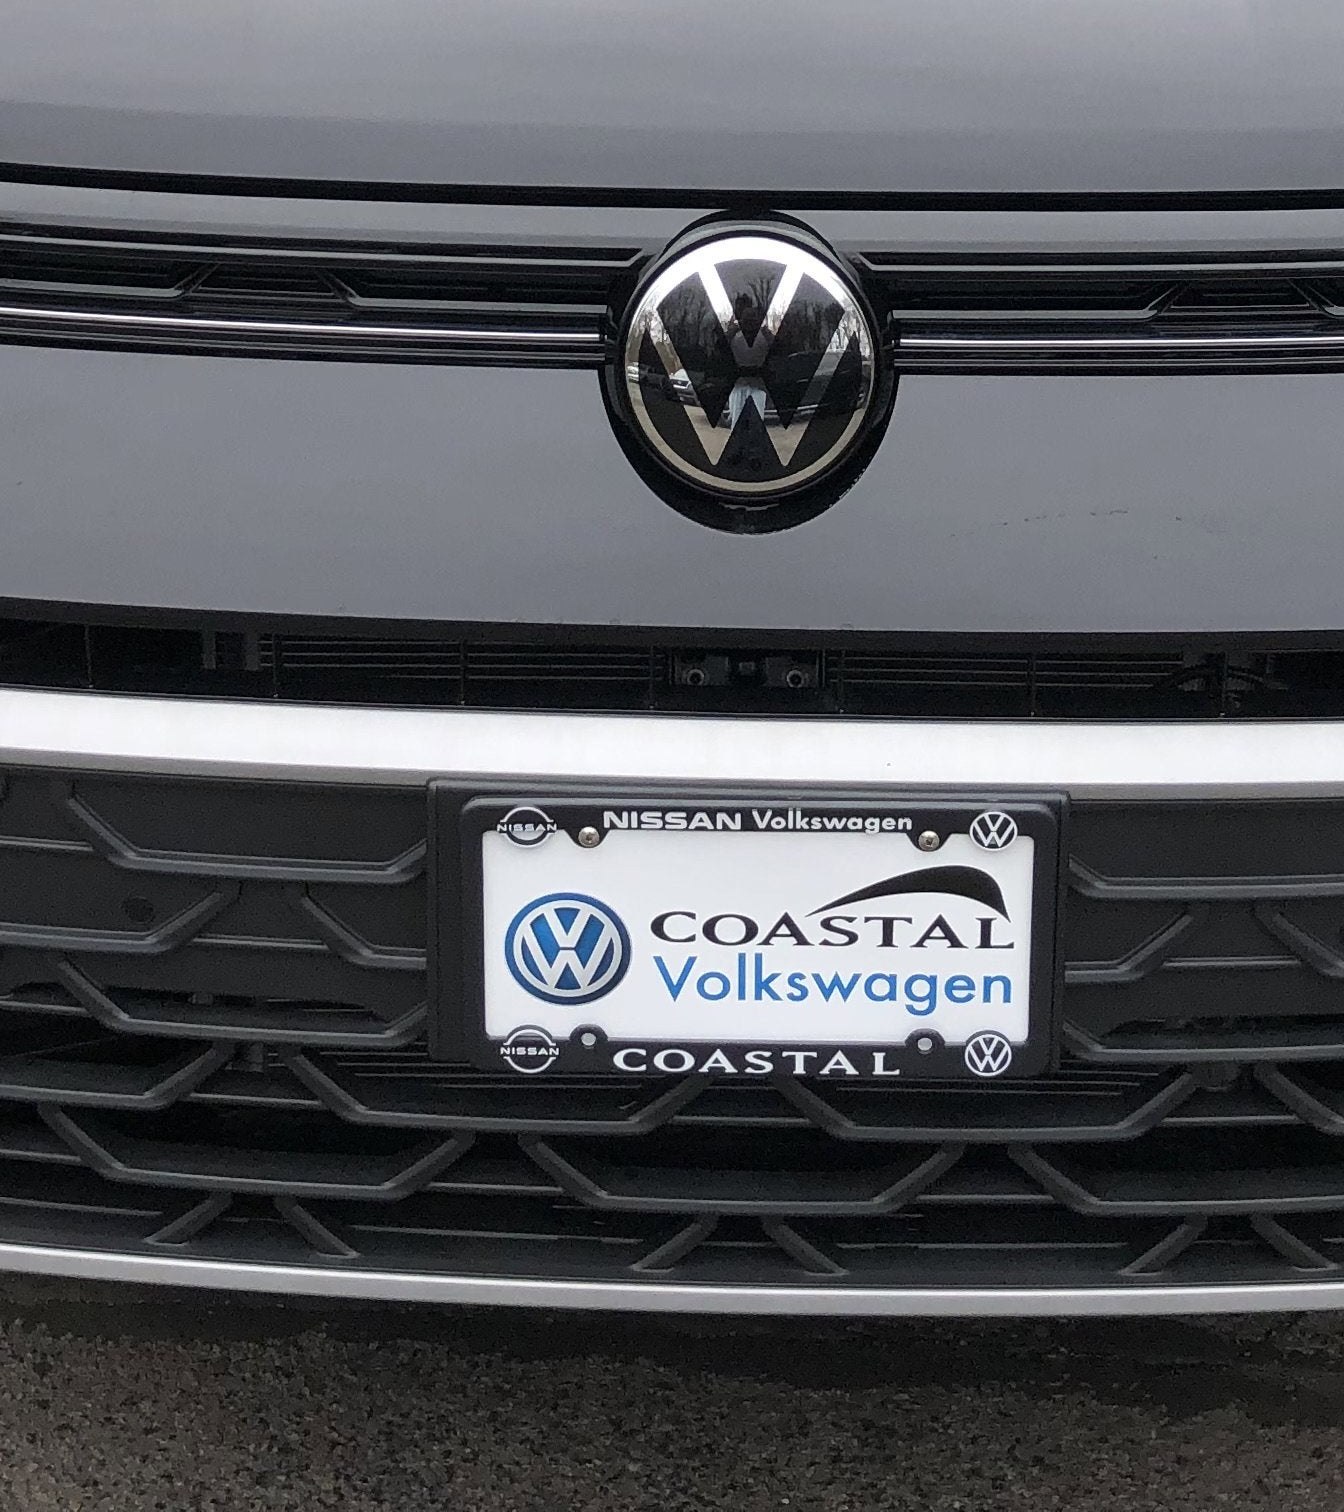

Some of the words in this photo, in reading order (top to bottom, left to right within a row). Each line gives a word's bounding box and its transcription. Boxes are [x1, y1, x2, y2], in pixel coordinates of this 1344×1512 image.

[497, 822, 558, 832] NISSAN
[602, 810, 742, 831] NISSAN
[751, 809, 913, 834] Volkswagen
[650, 911, 1014, 949] COASTAL
[653, 953, 1012, 1016] Volkswagen
[499, 1045, 559, 1057] NISSAN
[612, 1049, 900, 1076] COASTAL
